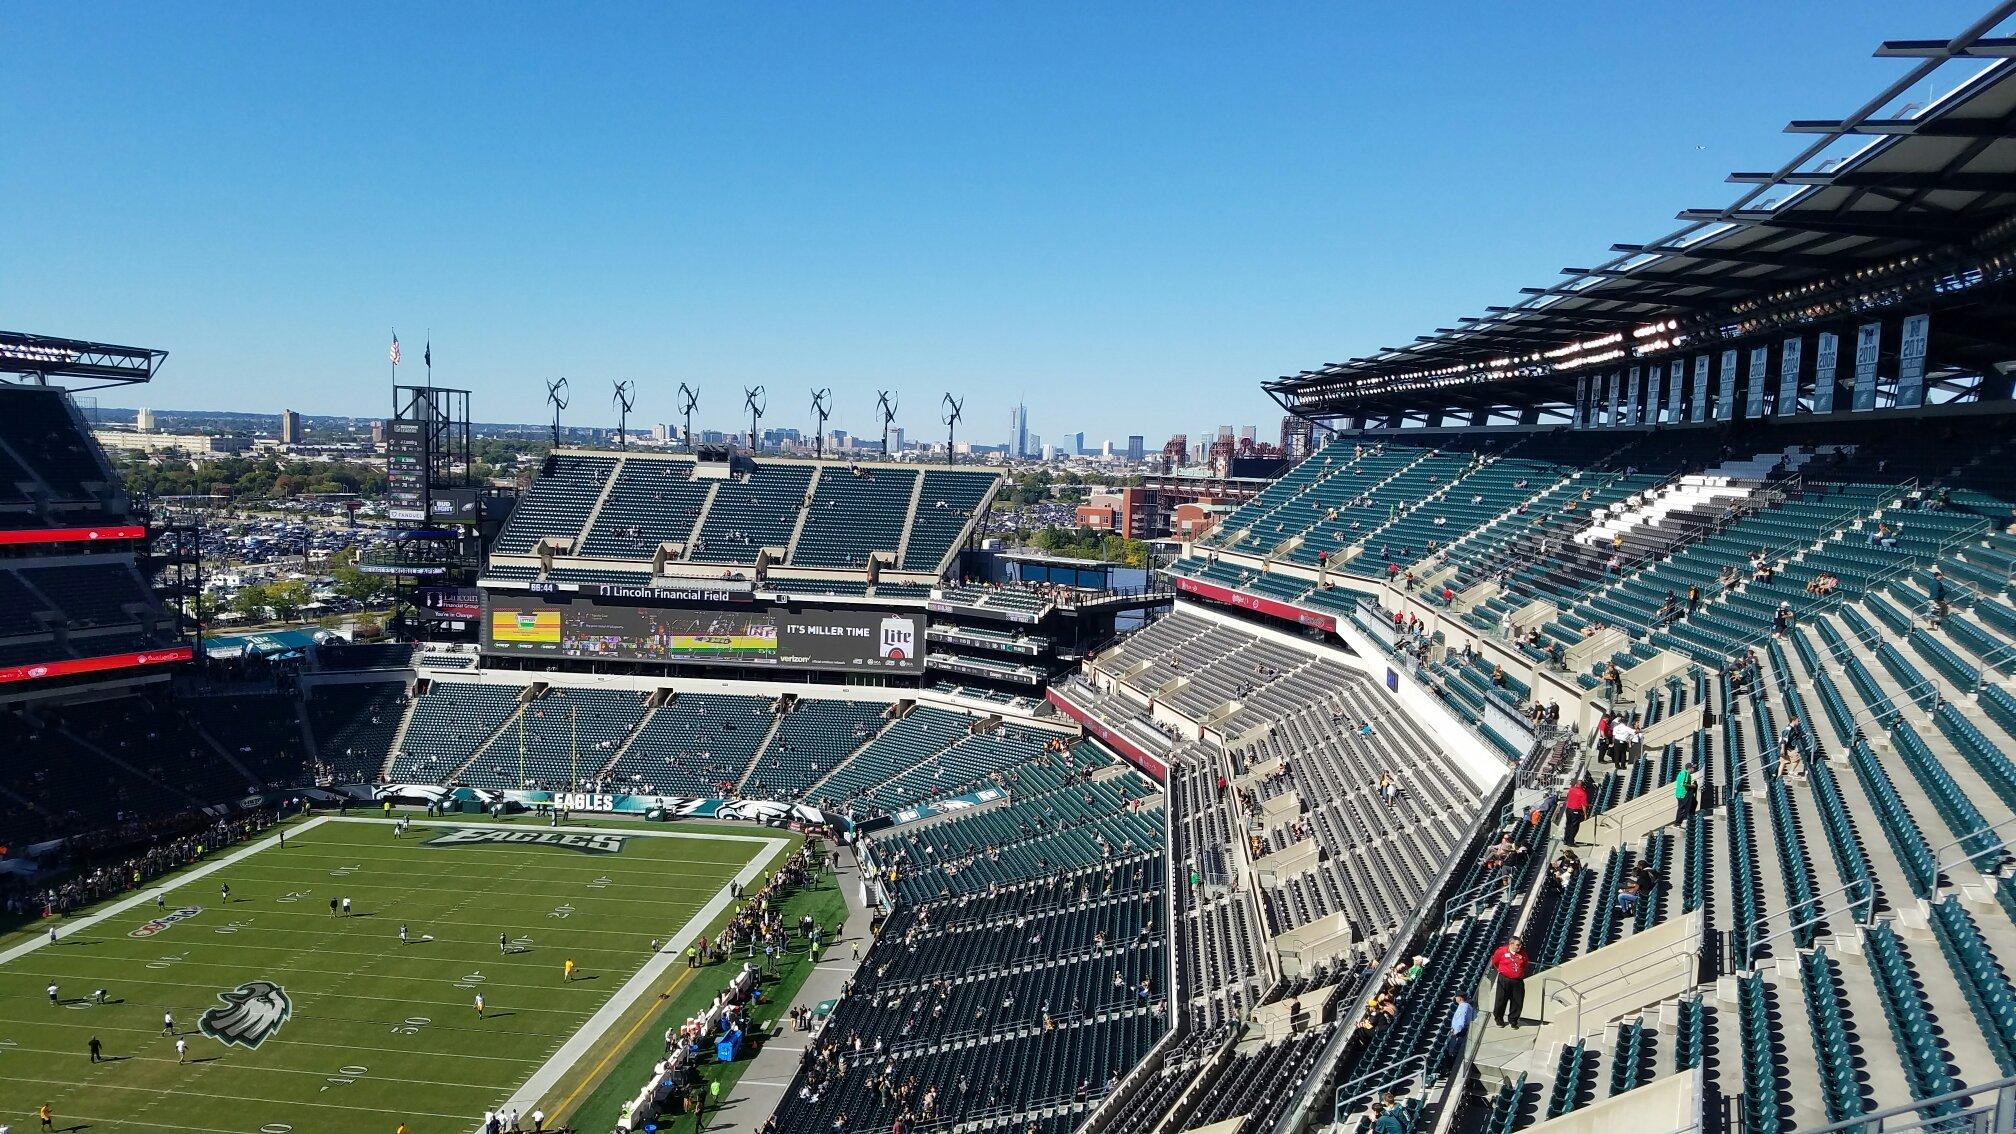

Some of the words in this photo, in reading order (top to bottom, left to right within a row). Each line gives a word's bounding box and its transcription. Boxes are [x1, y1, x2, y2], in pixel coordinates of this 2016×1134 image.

[1859, 345, 1876, 363] 2010
[1903, 338, 1925, 357] 2013
[1783, 358, 1798, 373] 2004
[1818, 352, 1835, 368] 2006
[444, 592, 478, 602] Lincoln
[614, 586, 652, 599] Lincoln
[655, 588, 701, 601] Financial
[703, 590, 730, 602] Field
[787, 624, 806, 634] IT'S
[807, 625, 845, 637] MILLER
[846, 627, 871, 637] TIME
[883, 628, 912, 646] Lite
[780, 655, 809, 663] verizon
[554, 793, 613, 811] EAGLES
[428, 829, 625, 853] EAGLES
[390, 1016, 432, 1035] 50
